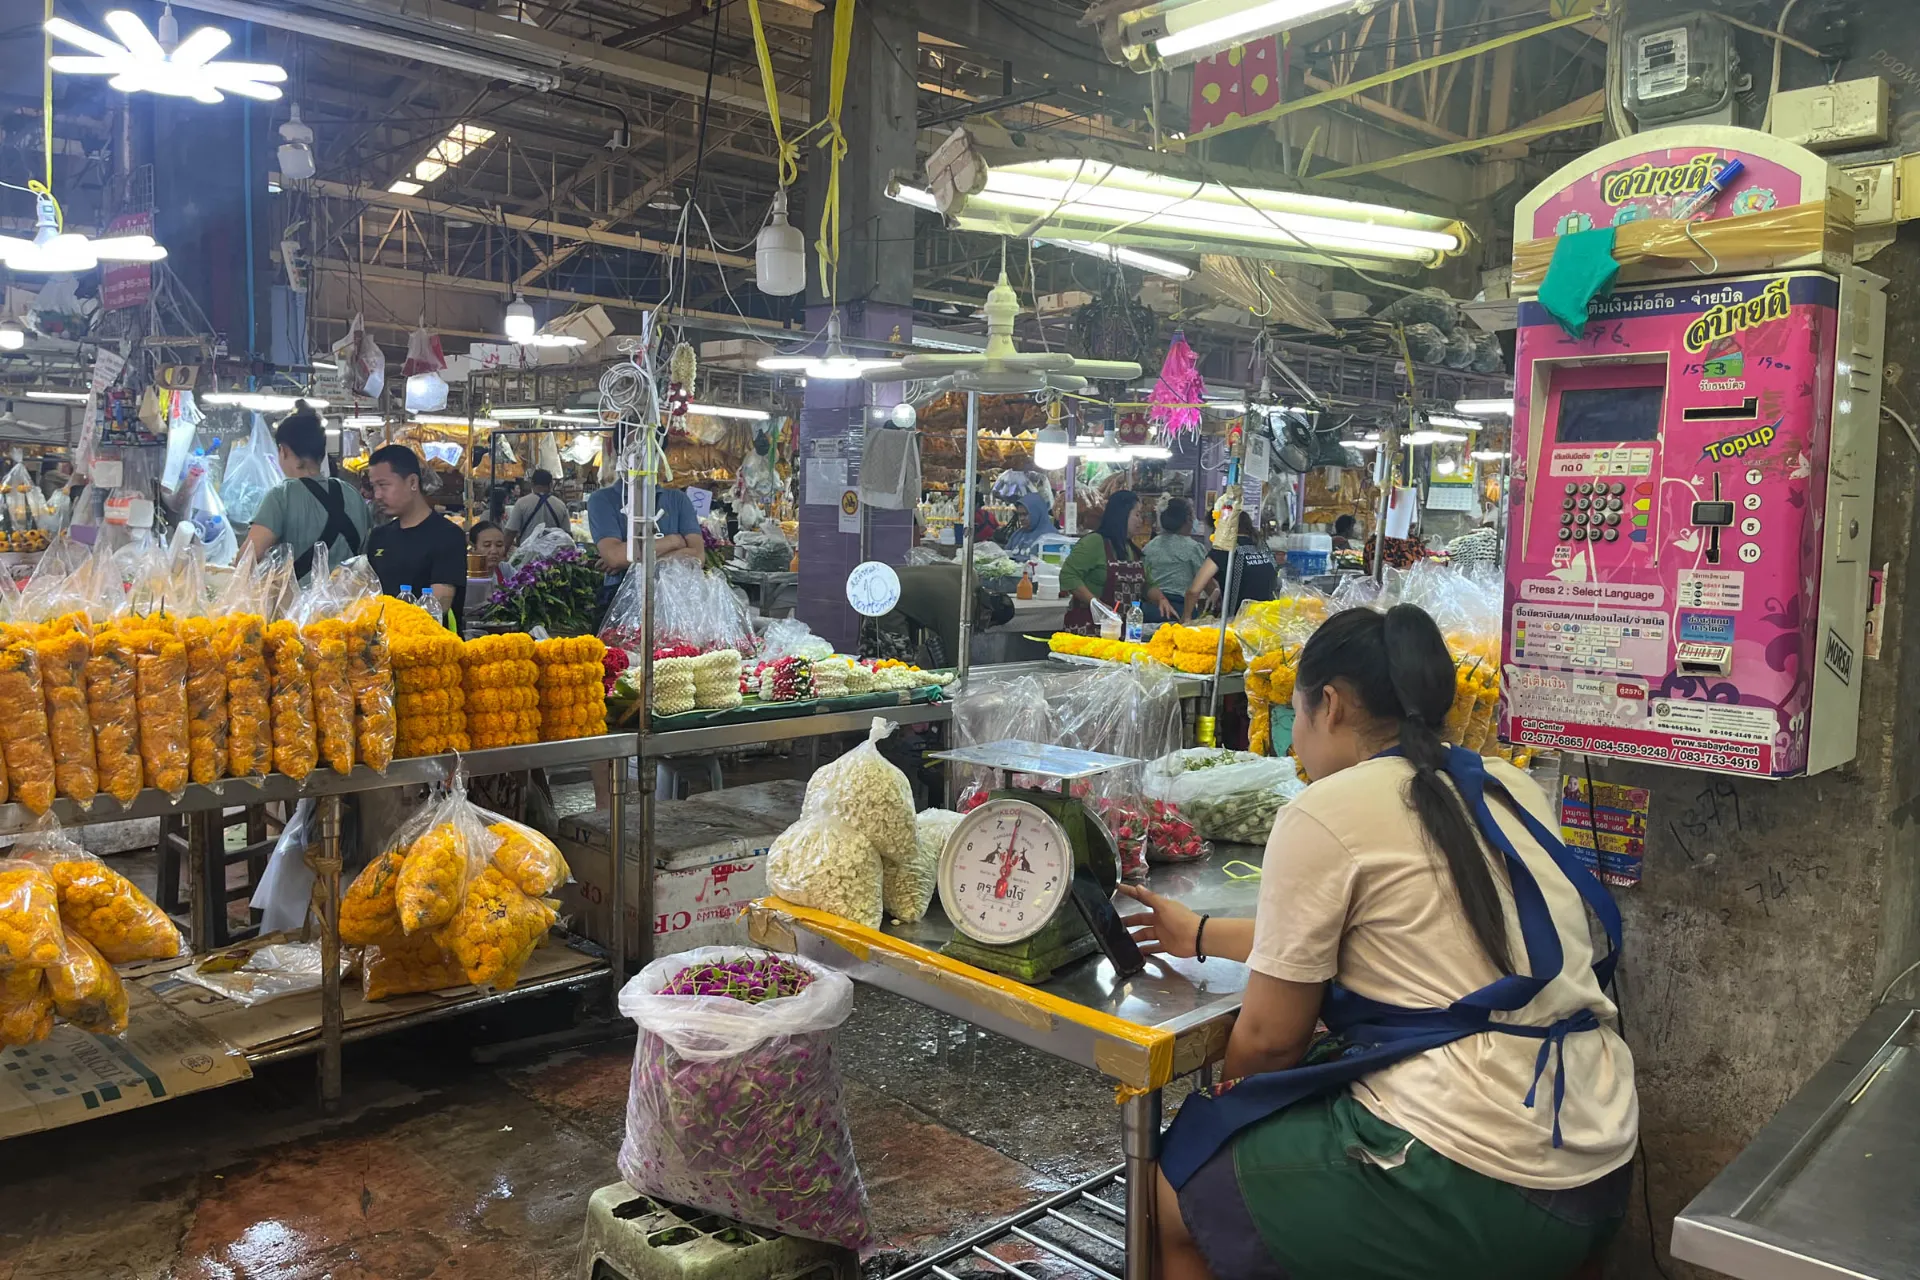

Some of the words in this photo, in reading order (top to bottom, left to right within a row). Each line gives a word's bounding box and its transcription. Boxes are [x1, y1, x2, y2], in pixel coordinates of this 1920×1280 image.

[1607, 154, 1712, 204] สบายดี
[1588, 292, 1675, 315] ติมเงินมือถือ
[1691, 287, 1743, 307] จ่ายบิล
[1686, 281, 1789, 349] สบายดี
[1704, 426, 1775, 461] Topup
[1749, 472, 1757, 482] 1
[1748, 498, 1757, 507] 2
[1746, 523, 1755, 531] 5
[1743, 549, 1757, 557] 10
[1528, 584, 1556, 594] Press
[1558, 586, 1564, 595] 2
[1572, 586, 1602, 597] Select
[1604, 588, 1655, 601] Language
[1825, 636, 1849, 678] MORSA
[1521, 674, 1566, 689] ตู้เติมเงิน
[1522, 720, 1537, 729] Call
[1538, 721, 1564, 732] Center
[1521, 731, 1583, 748] 02-577-6865
[1594, 740, 1668, 758] 084-559-9248
[1680, 750, 1759, 769] 083-753-4919
[1672, 738, 1758, 756] www.sabaydee.net
[996, 820, 1003, 829] 7
[1015, 819, 1022, 829] 0
[966, 842, 973, 851] 6
[1044, 842, 1050, 851] 1
[959, 883, 966, 893] 5
[1044, 882, 1051, 891] 2
[979, 911, 986, 921] 4
[1017, 911, 1024, 921] 3
